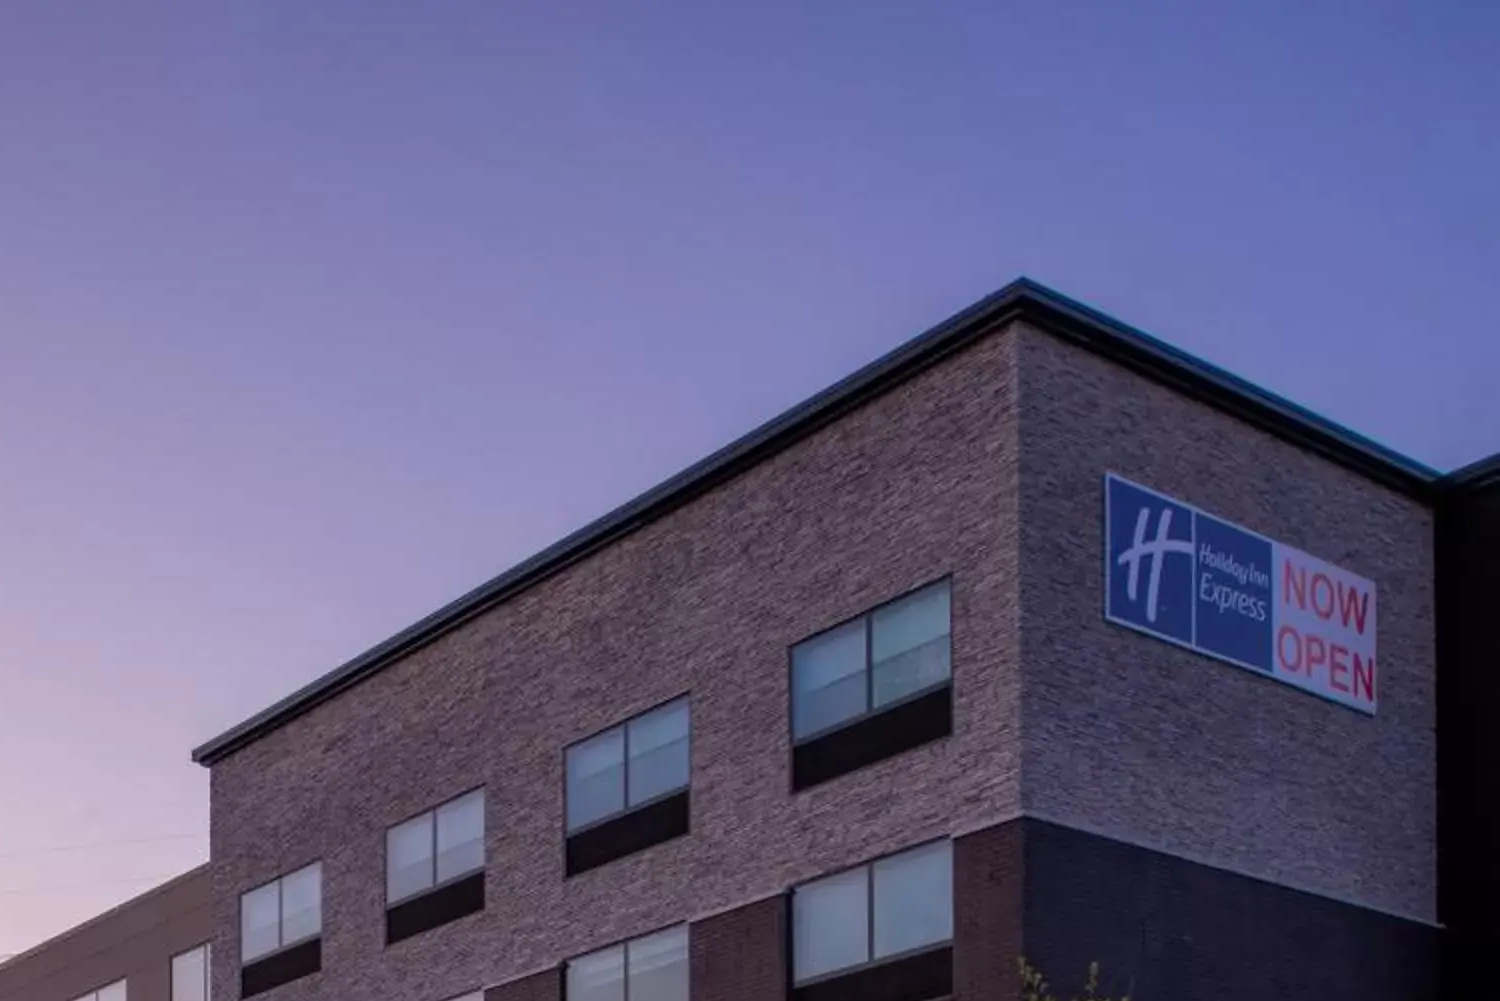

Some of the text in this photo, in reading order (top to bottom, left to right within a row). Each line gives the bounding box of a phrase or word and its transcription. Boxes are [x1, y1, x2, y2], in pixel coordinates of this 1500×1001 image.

[1200, 542, 1269, 588] Holiday Inn
[1200, 572, 1267, 621] Express
[1283, 558, 1369, 636] NOW
[1277, 624, 1373, 703] OPEN
